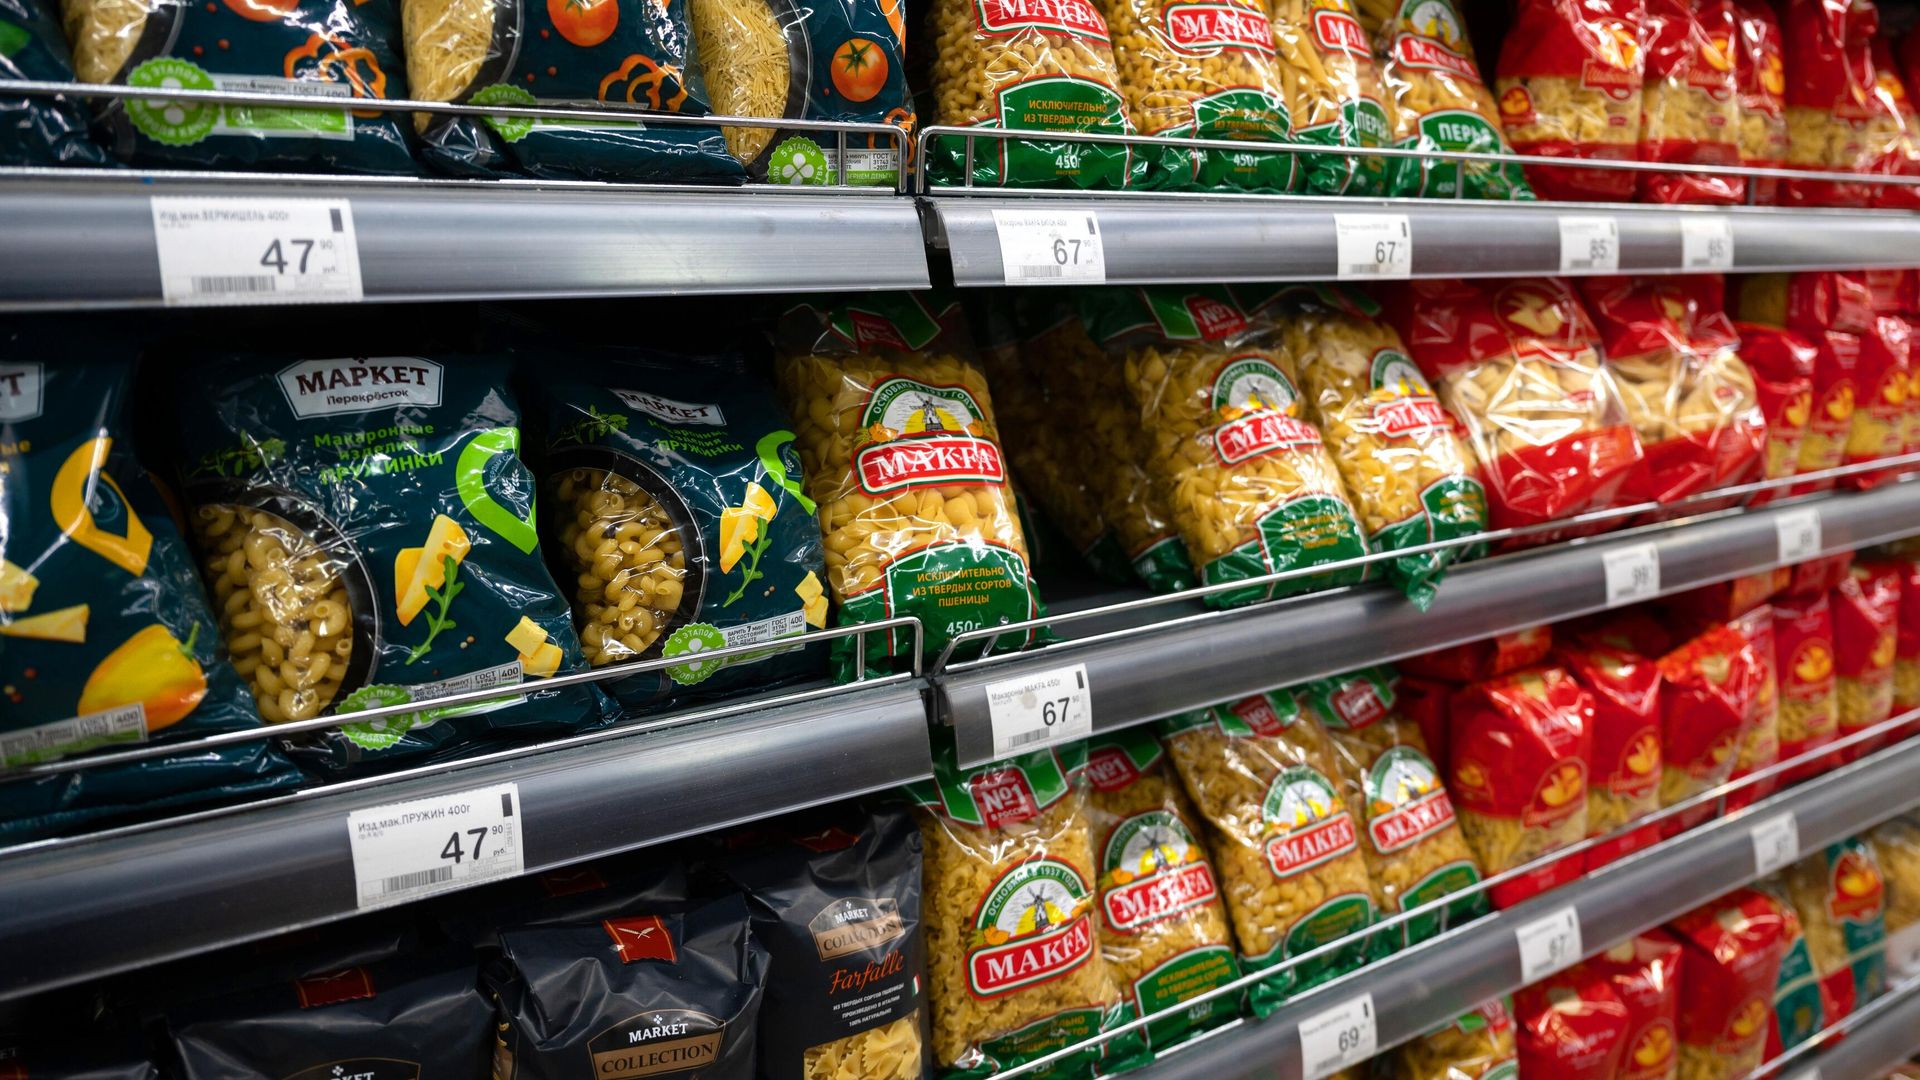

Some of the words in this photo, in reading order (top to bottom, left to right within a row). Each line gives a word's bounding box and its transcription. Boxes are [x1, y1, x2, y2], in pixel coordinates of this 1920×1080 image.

[1029, 100, 1107, 112] ИСКЛЮЧИТЕЛЬНО
[1024, 114, 1035, 122] ИЗ
[1038, 114, 1075, 124] ТВЕРДЫХ
[1055, 155, 1081, 169] 450г
[1233, 154, 1259, 166] 450г
[260, 239, 314, 275] 47
[1054, 239, 1081, 265] 67
[1376, 241, 1395, 264] 67
[296, 366, 429, 395] МАРКЕТ
[619, 392, 708, 418] МАРКЕТ
[314, 424, 434, 447] Макаронные
[339, 440, 418, 461] изделия
[657, 439, 744, 457] ПРУЖИНКИ
[873, 446, 996, 481] MAKFA
[917, 567, 1005, 583] ИСКЛЮЧИТЕЛЬНО
[912, 587, 926, 597] ИЗ
[928, 581, 972, 595] ТВЕРДЫХ
[975, 578, 1012, 591] СОРТОВ
[939, 594, 989, 608] ПШЕНИЦЫ
[771, 618, 787, 626] ГОСТ
[790, 615, 803, 625] 400
[682, 629, 714, 639] ЭТАПОВ
[728, 629, 746, 637] ВАРИТЬ
[475, 671, 496, 680] ГОСТ
[502, 667, 519, 677] 400
[1043, 697, 1070, 726] 67
[358, 810, 445, 832] Изд.мак.ПРУЖИН
[448, 804, 471, 816] 400г
[492, 824, 503, 835] 90
[440, 827, 488, 864] 47
[1277, 822, 1351, 868] MAKFA
[1041, 867, 1059, 876] 1937
[835, 908, 869, 924] MARKET
[824, 921, 897, 951] COLLECTION
[985, 926, 1088, 983] MAKFA
[829, 949, 904, 995] Farfalle
[849, 1017, 861, 1027] 100%
[629, 1023, 688, 1043] MARKET
[1339, 1026, 1359, 1052] 69
[602, 1042, 713, 1073] COLLECTION
